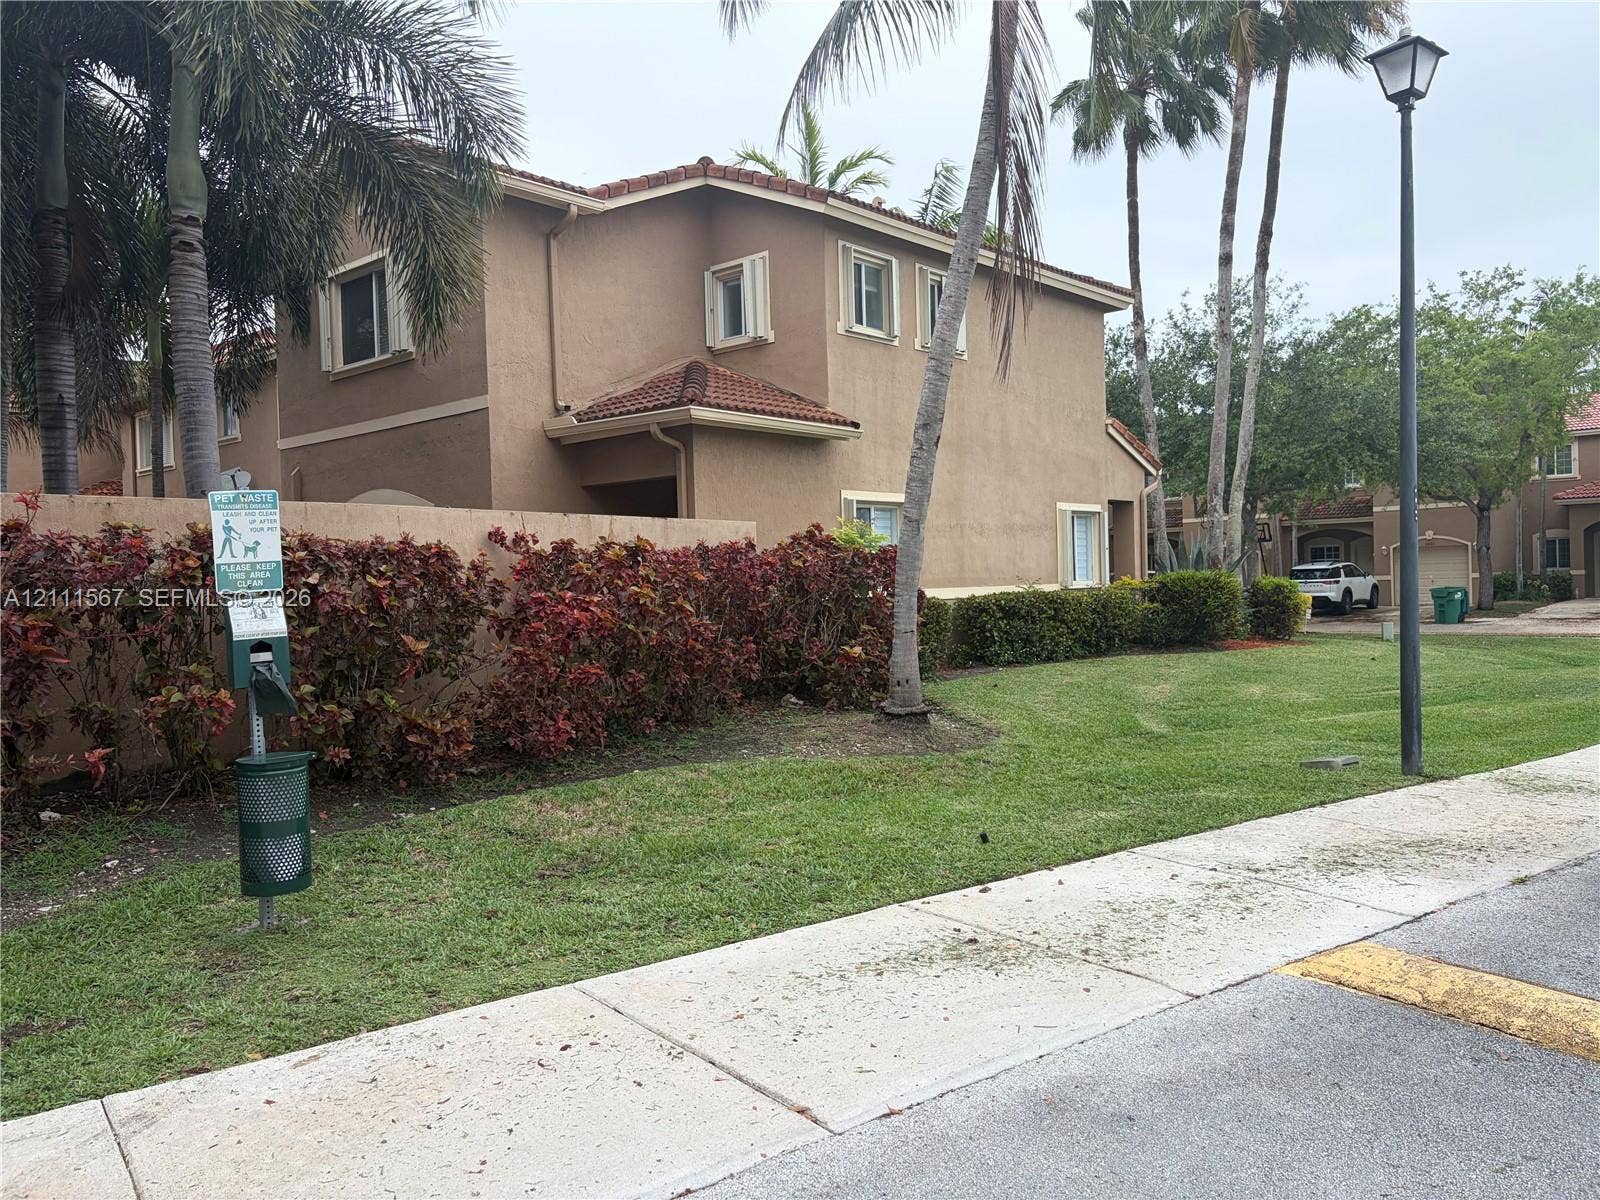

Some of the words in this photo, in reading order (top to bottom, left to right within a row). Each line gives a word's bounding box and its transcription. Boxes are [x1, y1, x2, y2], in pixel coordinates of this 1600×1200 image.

[214, 494, 235, 503] PET
[239, 493, 274, 503] WASTE
[221, 563, 252, 572] PLEASE
[256, 562, 277, 570] KEEP
[228, 572, 246, 580] THIS
[236, 580, 264, 588] CLEAN
